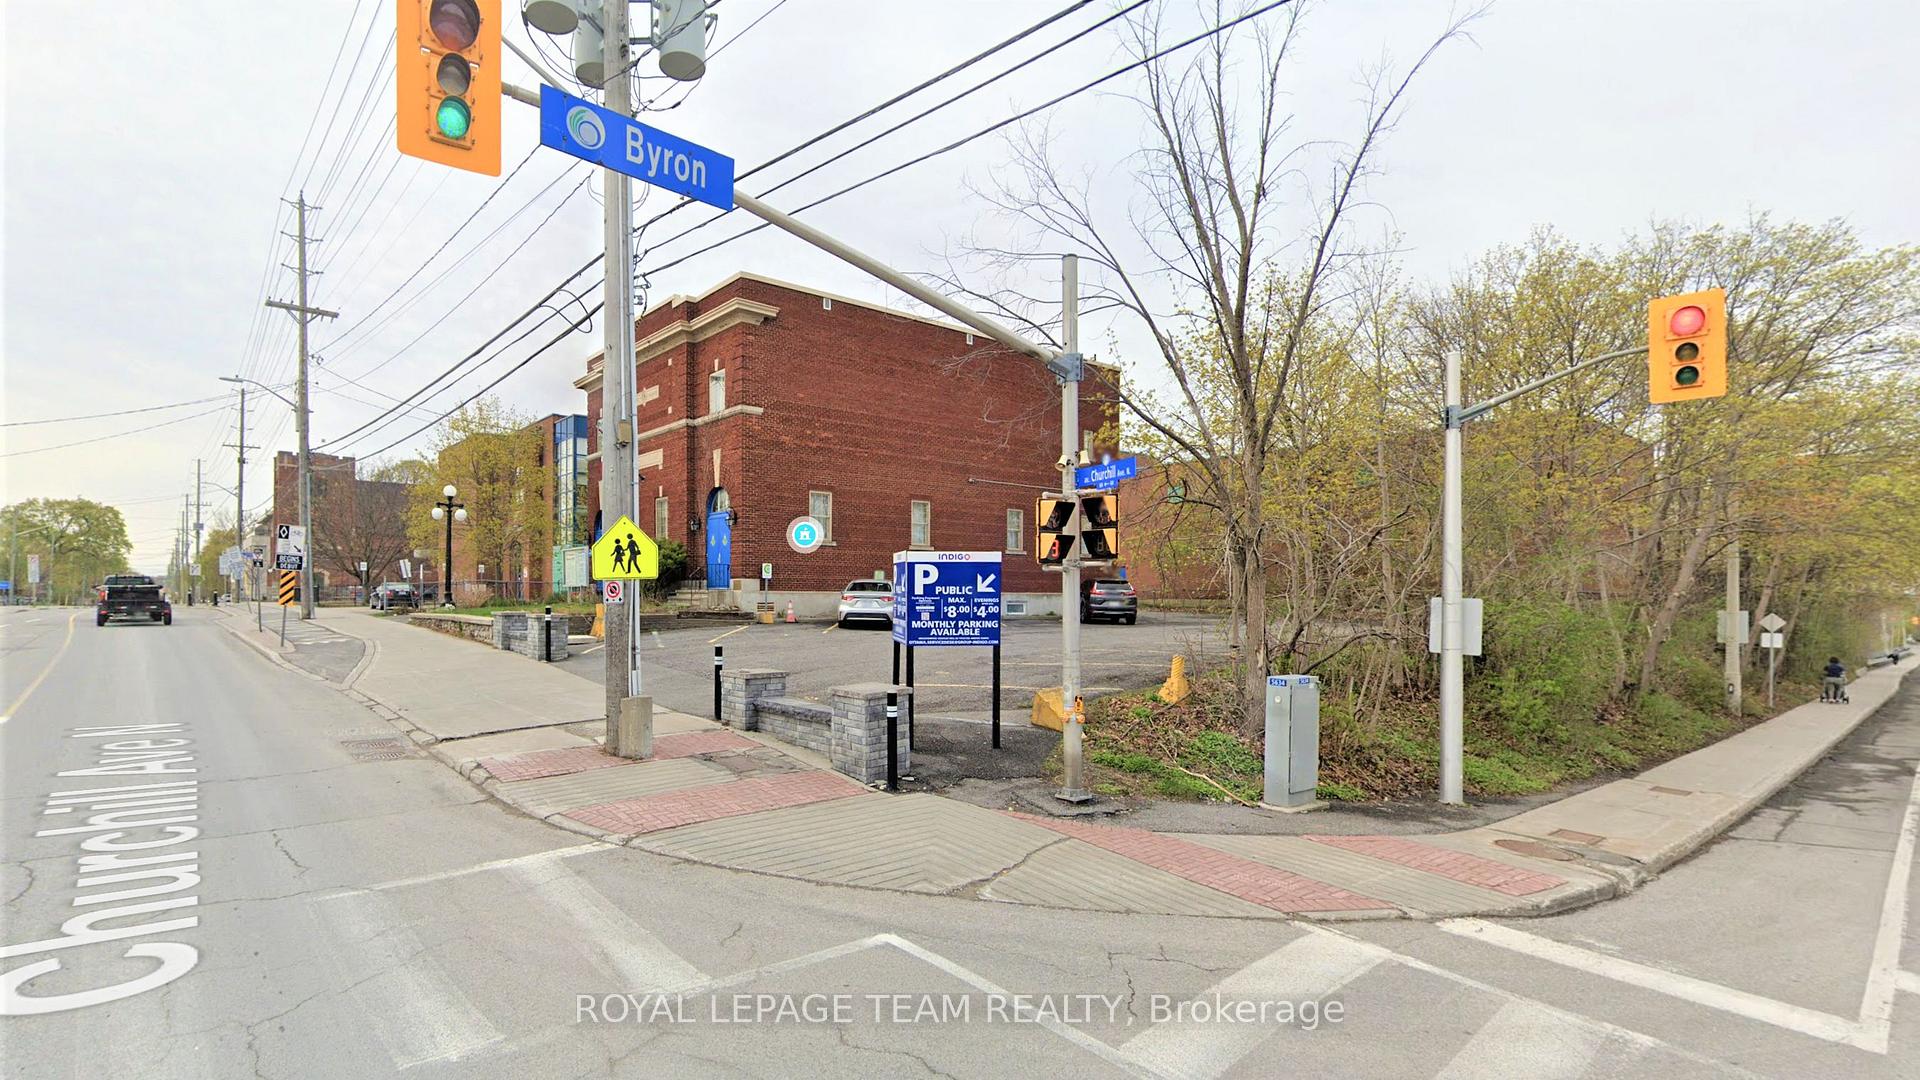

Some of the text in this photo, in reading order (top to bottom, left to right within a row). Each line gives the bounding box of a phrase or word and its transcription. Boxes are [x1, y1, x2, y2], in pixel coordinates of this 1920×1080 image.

[626, 124, 707, 189] Byron
[1091, 464, 1116, 482] Churchill
[938, 553, 971, 561] INDIGO
[914, 563, 973, 595] P PUBLIC
[943, 606, 970, 618] $8.00
[973, 606, 999, 618] $4.00
[911, 620, 999, 628] MONTHLY PARKING
[930, 628, 980, 636] AVAILABLE
